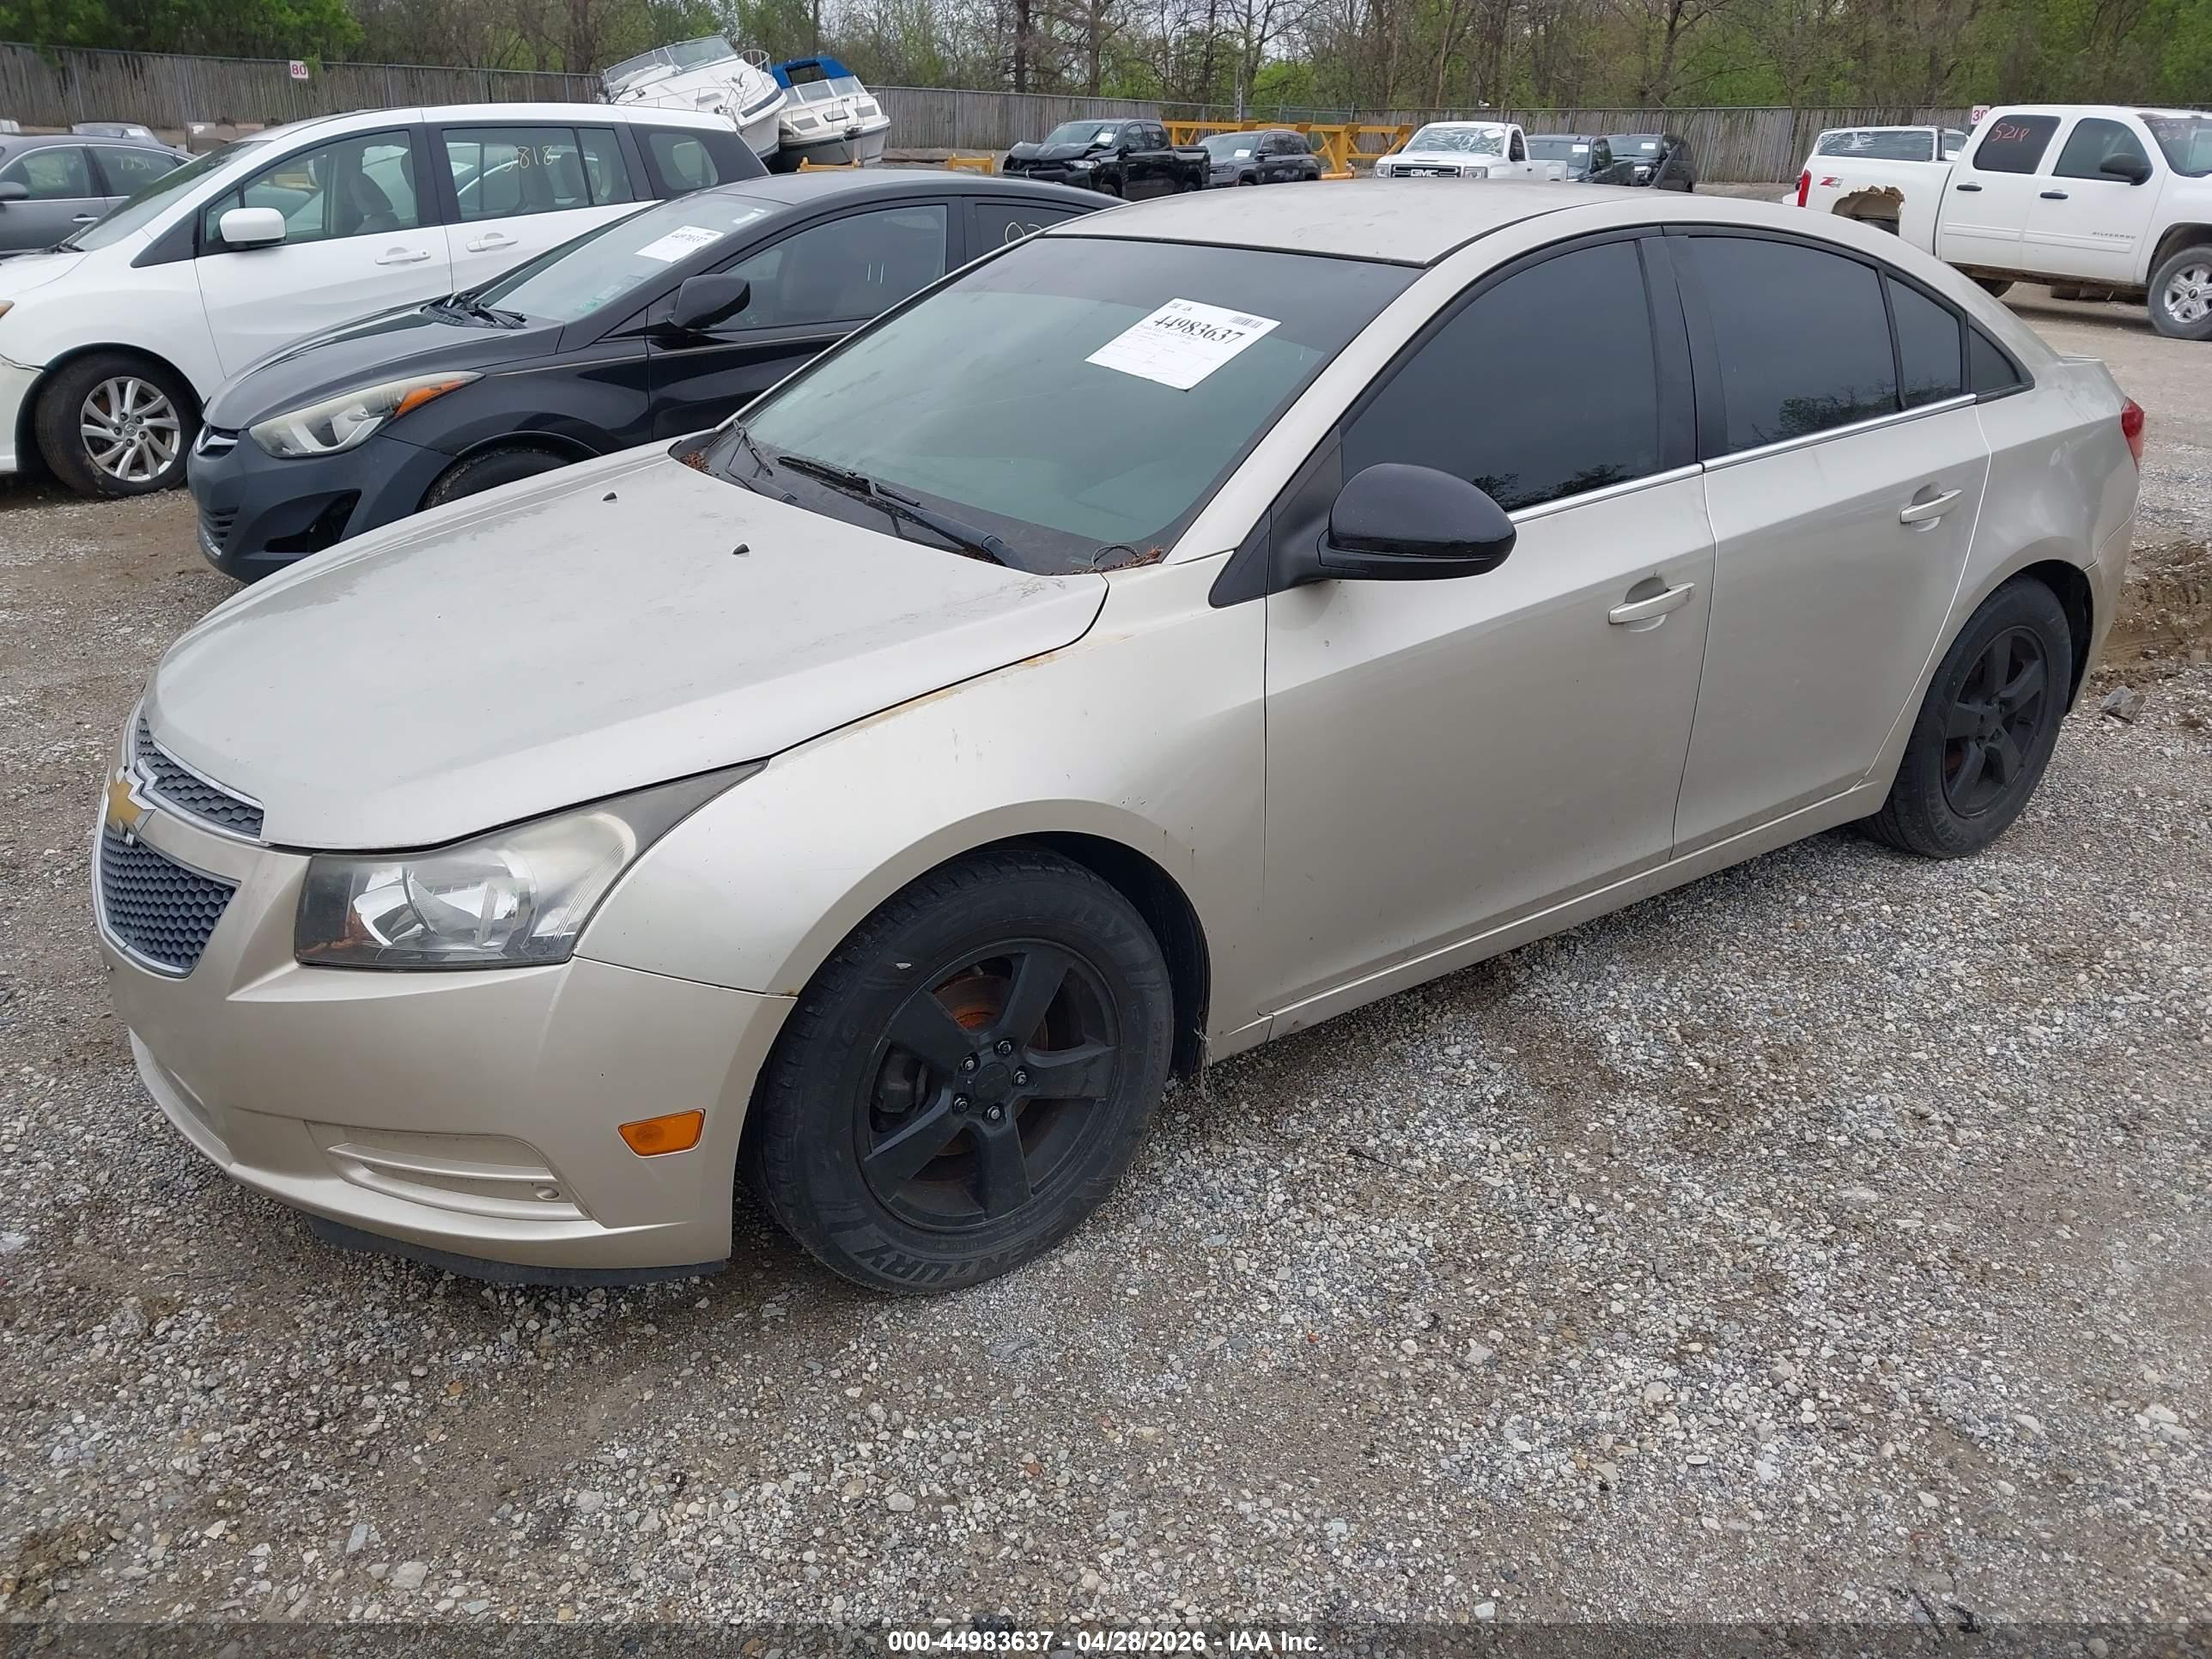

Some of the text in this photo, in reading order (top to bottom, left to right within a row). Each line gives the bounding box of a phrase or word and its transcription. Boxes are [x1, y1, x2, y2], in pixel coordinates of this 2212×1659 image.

[292, 64, 307, 76] 80
[1410, 169, 1439, 178] GMC
[1153, 314, 1246, 344] 44983637
